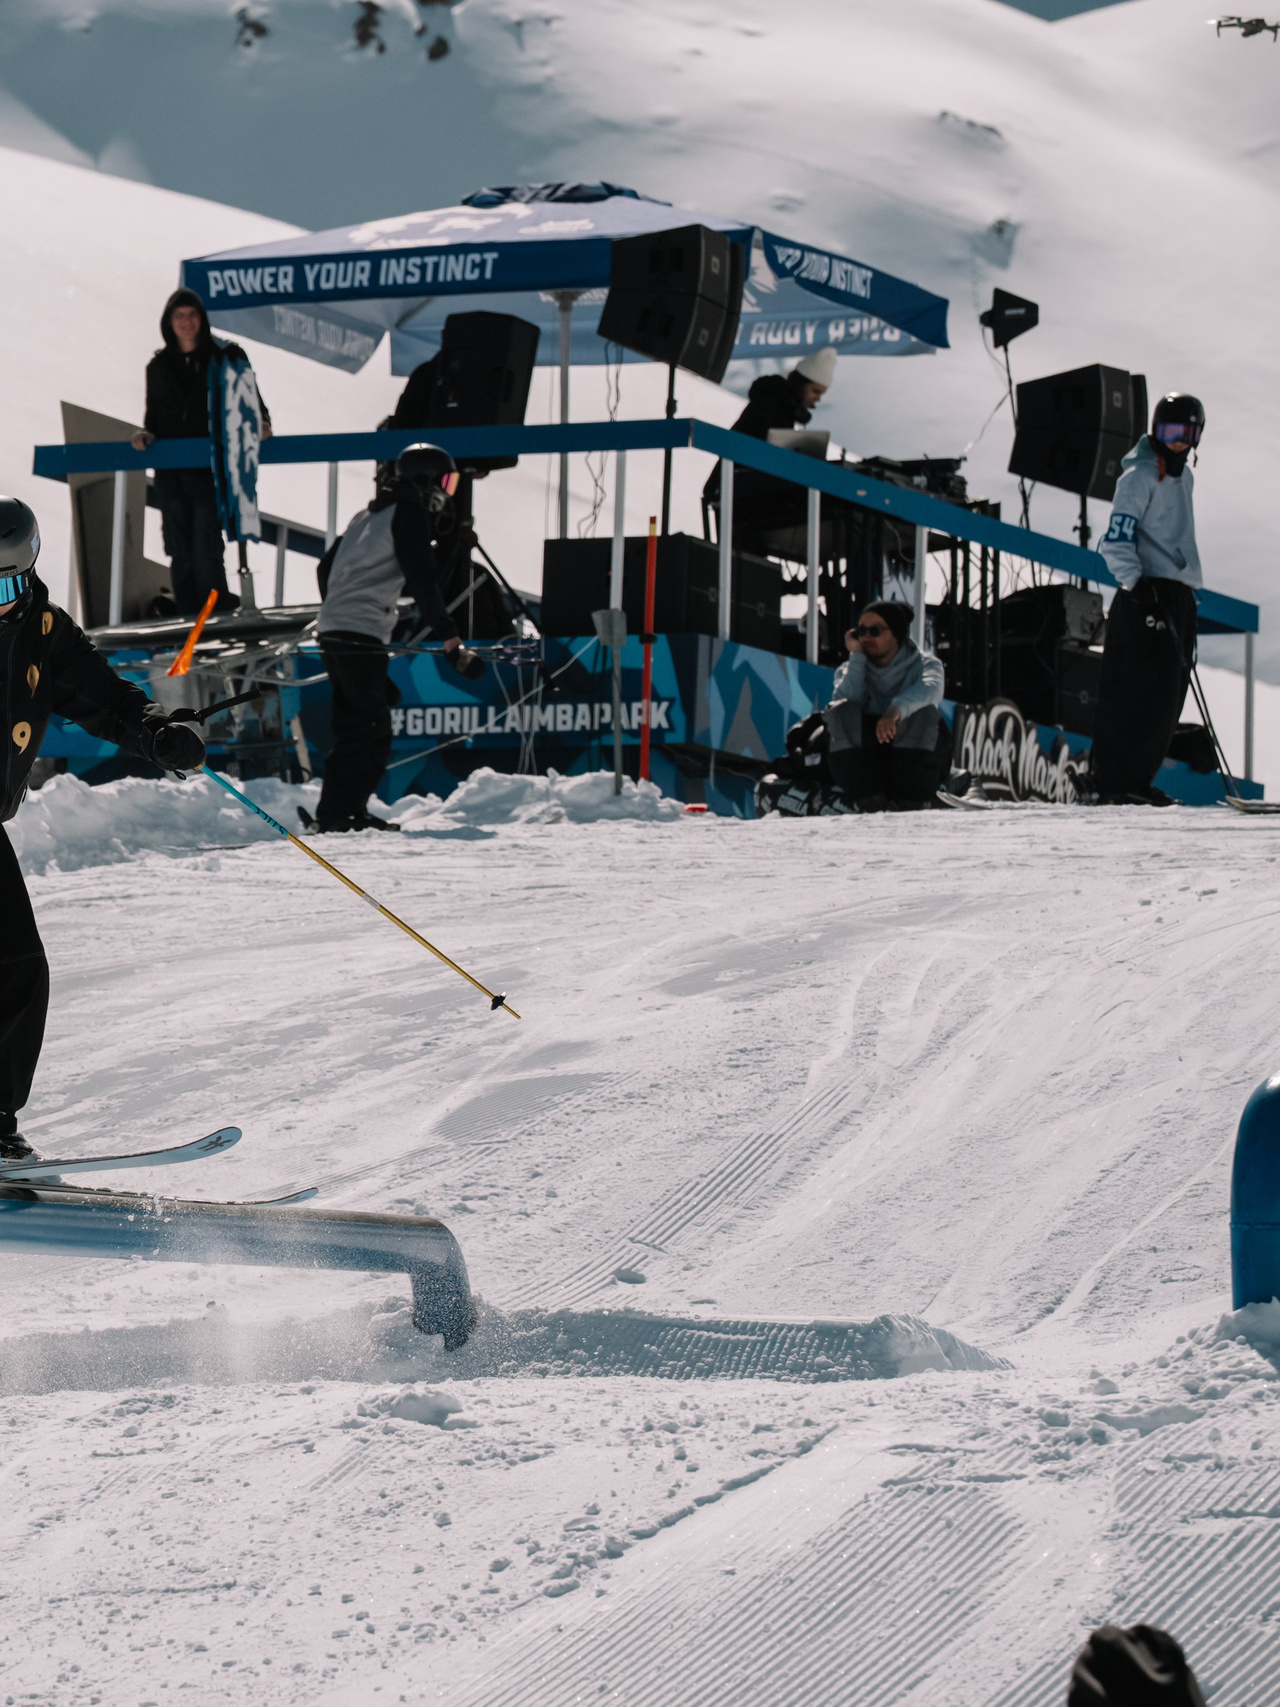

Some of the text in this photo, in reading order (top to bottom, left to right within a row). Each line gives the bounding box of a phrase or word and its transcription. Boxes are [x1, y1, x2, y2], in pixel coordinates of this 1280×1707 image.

[207, 252, 499, 299] POWER YOUR INSTINCT
[1108, 515, 1136, 541] 54
